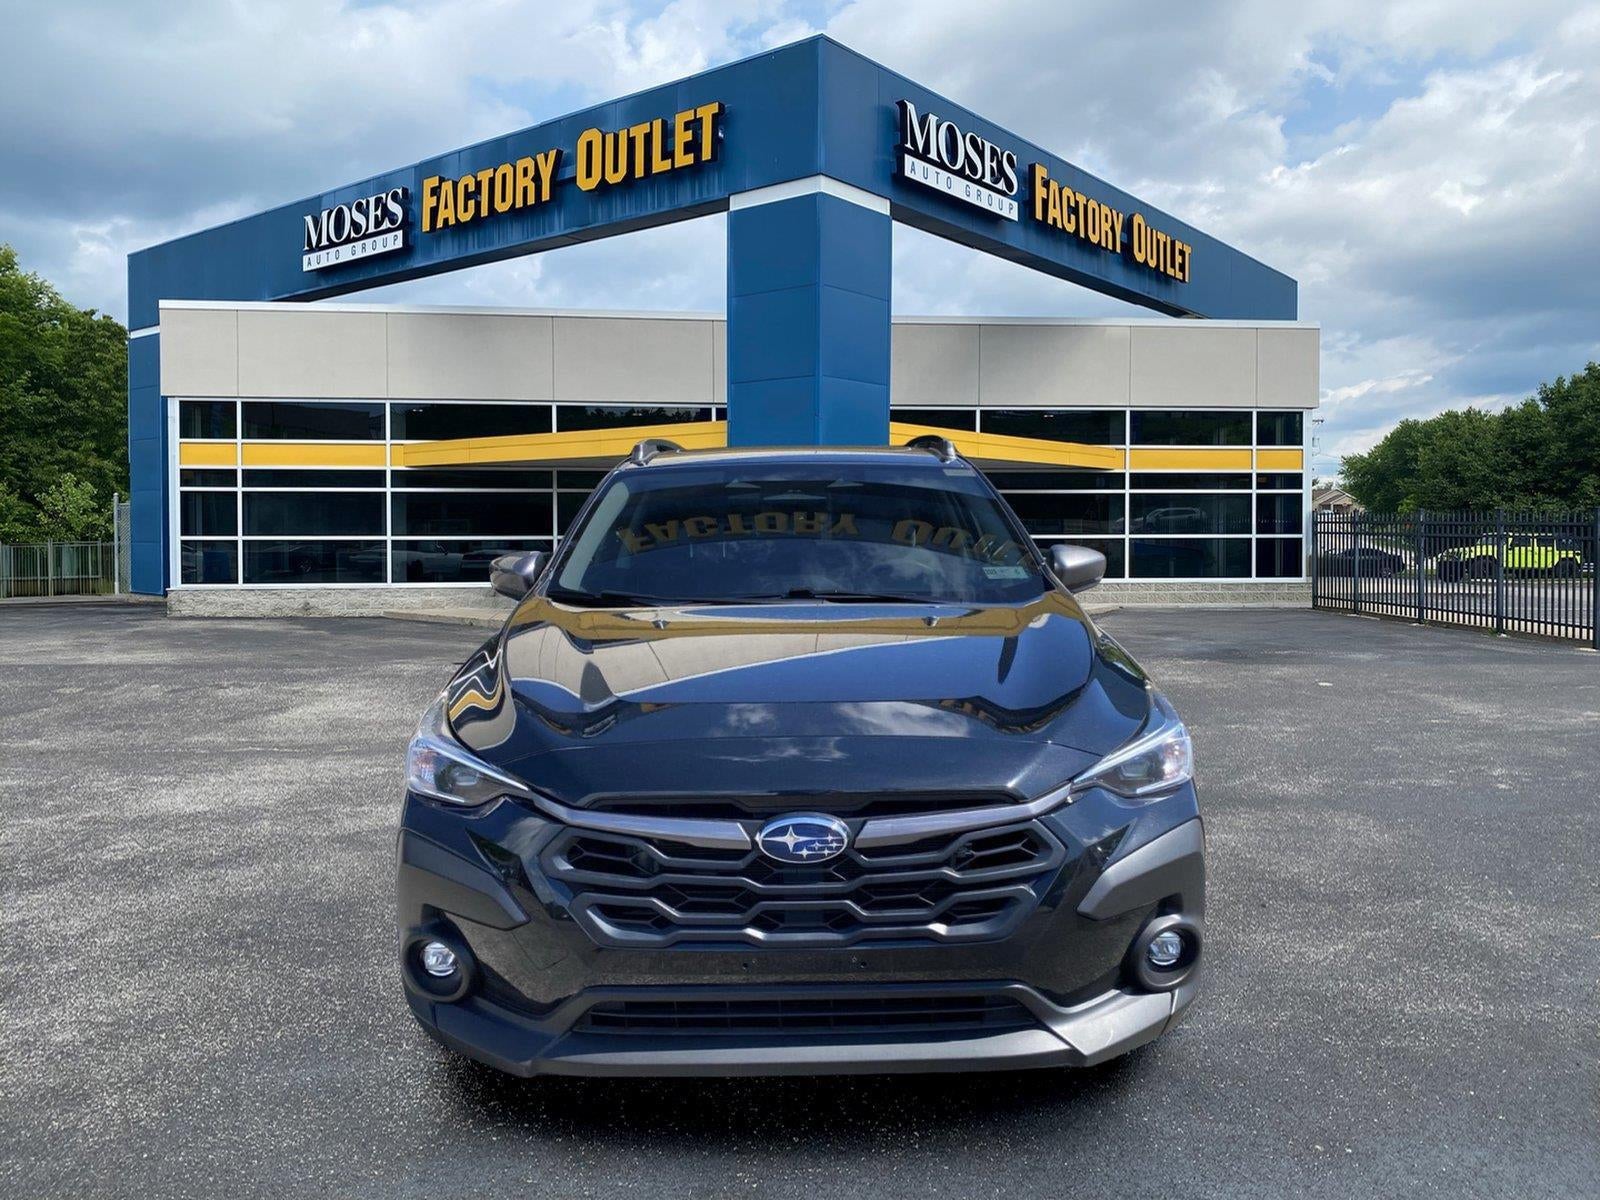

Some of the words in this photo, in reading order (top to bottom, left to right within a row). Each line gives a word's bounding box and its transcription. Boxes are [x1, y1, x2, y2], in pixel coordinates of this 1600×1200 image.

[422, 148, 559, 232] FACTORY
[576, 101, 721, 191] OUTLET
[903, 99, 1018, 196] MOSES
[908, 160, 953, 190] AUTO
[964, 184, 1015, 215] GROUP
[303, 187, 404, 251] MOSES
[307, 249, 340, 267] AUTO
[350, 234, 399, 256] GROUP
[1034, 162, 1124, 254] FACTORY
[1131, 212, 1192, 283] OUTLET
